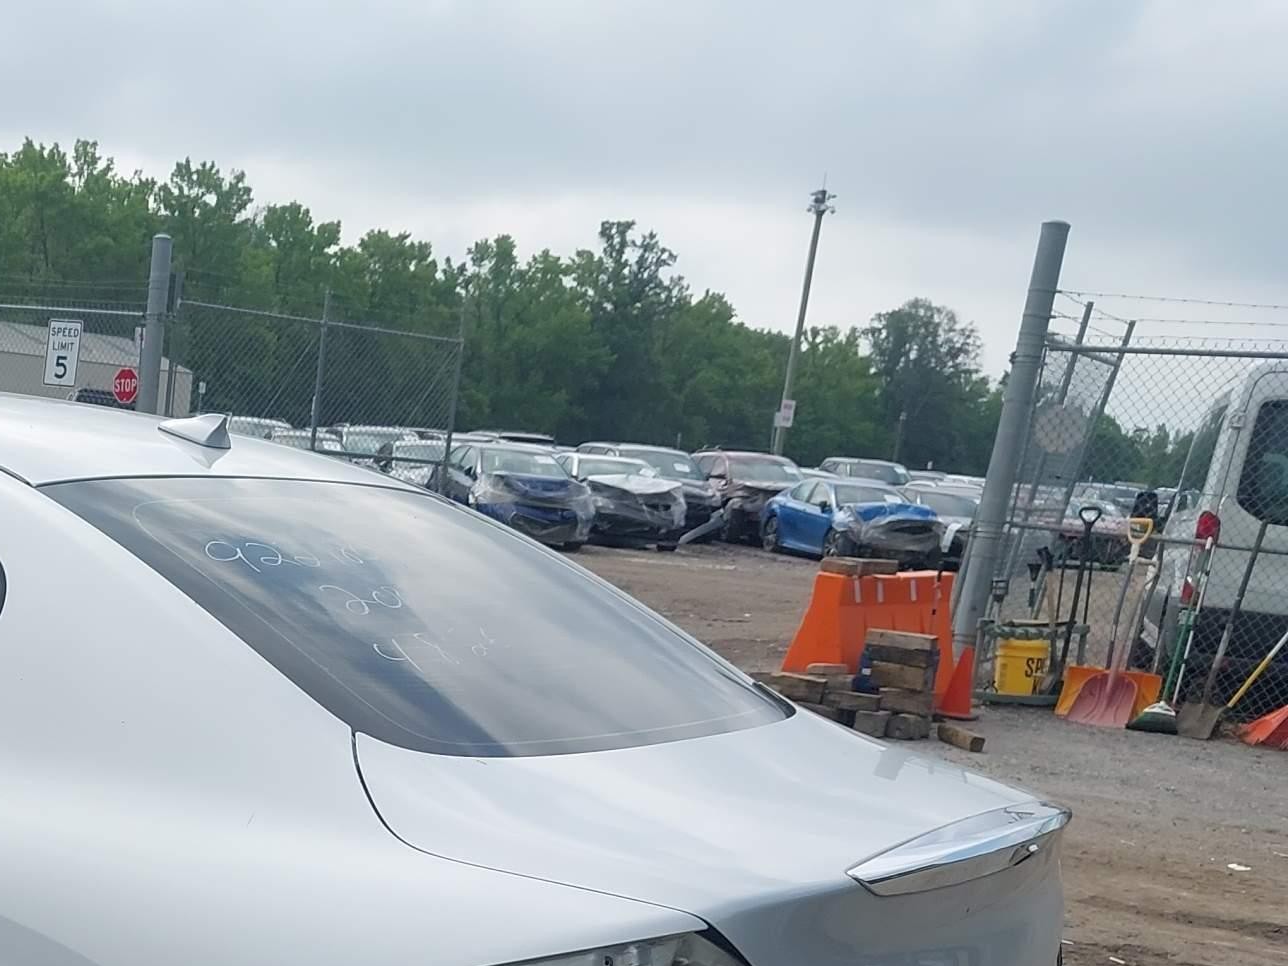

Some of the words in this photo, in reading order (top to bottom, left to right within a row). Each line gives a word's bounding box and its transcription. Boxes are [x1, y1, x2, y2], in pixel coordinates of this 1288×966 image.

[51, 327, 79, 338] SPEED
[52, 342, 74, 352] LIMIT
[54, 355, 67, 379] 5
[114, 378, 137, 393] STOP
